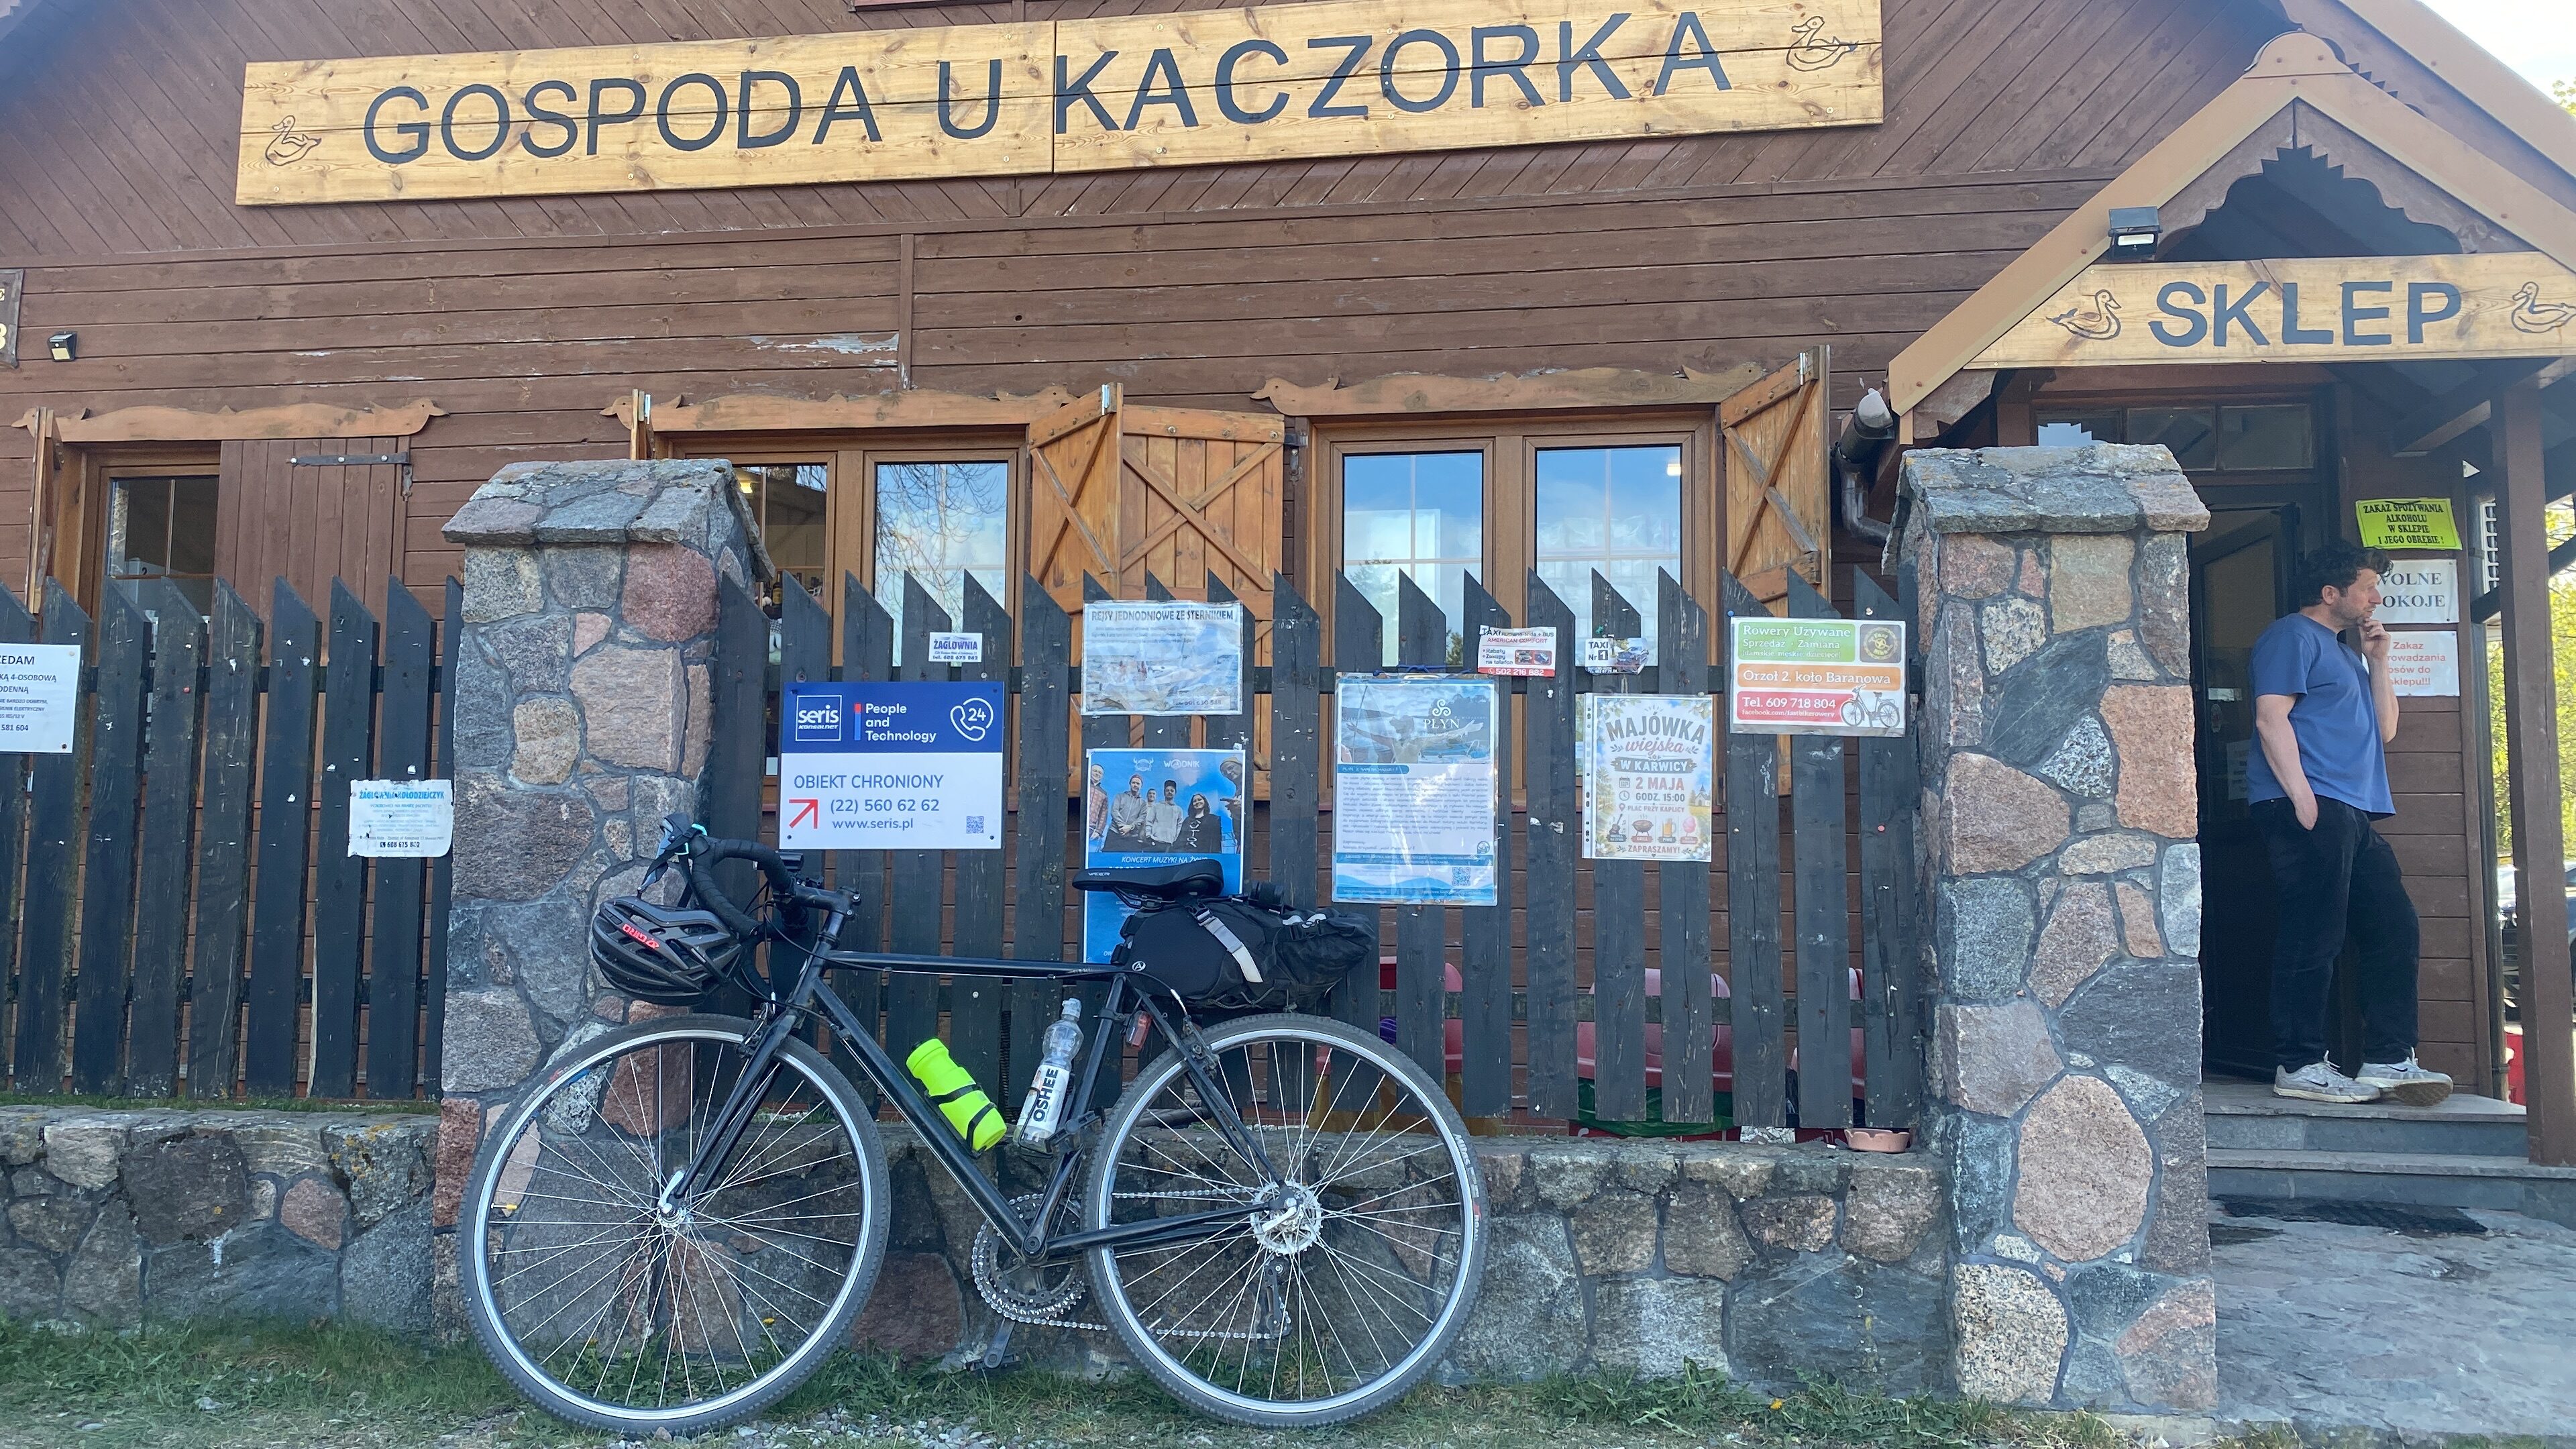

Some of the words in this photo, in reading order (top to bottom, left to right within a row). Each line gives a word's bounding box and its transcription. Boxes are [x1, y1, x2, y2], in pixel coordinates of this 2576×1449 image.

[362, 66, 883, 164] GOSPODA
[937, 58, 1002, 139] U
[1055, 11, 1733, 133] KACZORKA
[2148, 281, 2461, 347] SKLEP
[2363, 504, 2390, 513] ZAKAZ
[2386, 515, 2427, 523] ALKOHOLU
[2388, 525, 2396, 533] W
[2398, 525, 2430, 533] SKLEPIE
[2384, 535, 2404, 544] JEGO
[2383, 595, 2446, 607] OKOJE
[1176, 611, 1185, 620] ZE
[1482, 628, 1501, 636] TAXI
[1743, 626, 1790, 637] Rowery
[1797, 639, 1840, 648] Zamiana
[1600, 651, 1606, 659] 1
[11, 674, 56, 683] 4-OSOBOWĄ
[1743, 670, 1778, 681] Orzoł
[1795, 672, 1823, 682] koło
[1826, 673, 1890, 684] Baranowa
[1742, 697, 1763, 707] Tel.
[1766, 698, 1788, 708] 609
[1790, 698, 1811, 708] 718
[1813, 699, 1836, 709] 804
[798, 704, 839, 723] seris
[865, 703, 906, 716] People
[968, 708, 986, 721] 24
[865, 717, 890, 727] and
[1605, 711, 1705, 745] MAJÓWKA
[865, 731, 936, 743] Technology
[1626, 737, 1684, 755] wiejska
[1620, 760, 1631, 770] W
[1634, 760, 1688, 771] KARWICY
[794, 775, 847, 788] OBIEKT
[851, 775, 944, 789] CHRONIONY
[1635, 777, 1643, 790] 2
[1648, 777, 1684, 790] MAJA
[1635, 794, 1660, 802] GODZ.
[1663, 794, 1685, 802] 15:00
[830, 799, 859, 814] (22)
[864, 799, 892, 811] 560
[897, 799, 916, 811] 62
[921, 799, 940, 811] 62
[833, 818, 913, 830] www.seris.pl
[1628, 845, 1680, 853] ZAPRASZAMY!
[623, 924, 647, 942] GIRO
[1033, 1068, 1059, 1122] OSHEE
